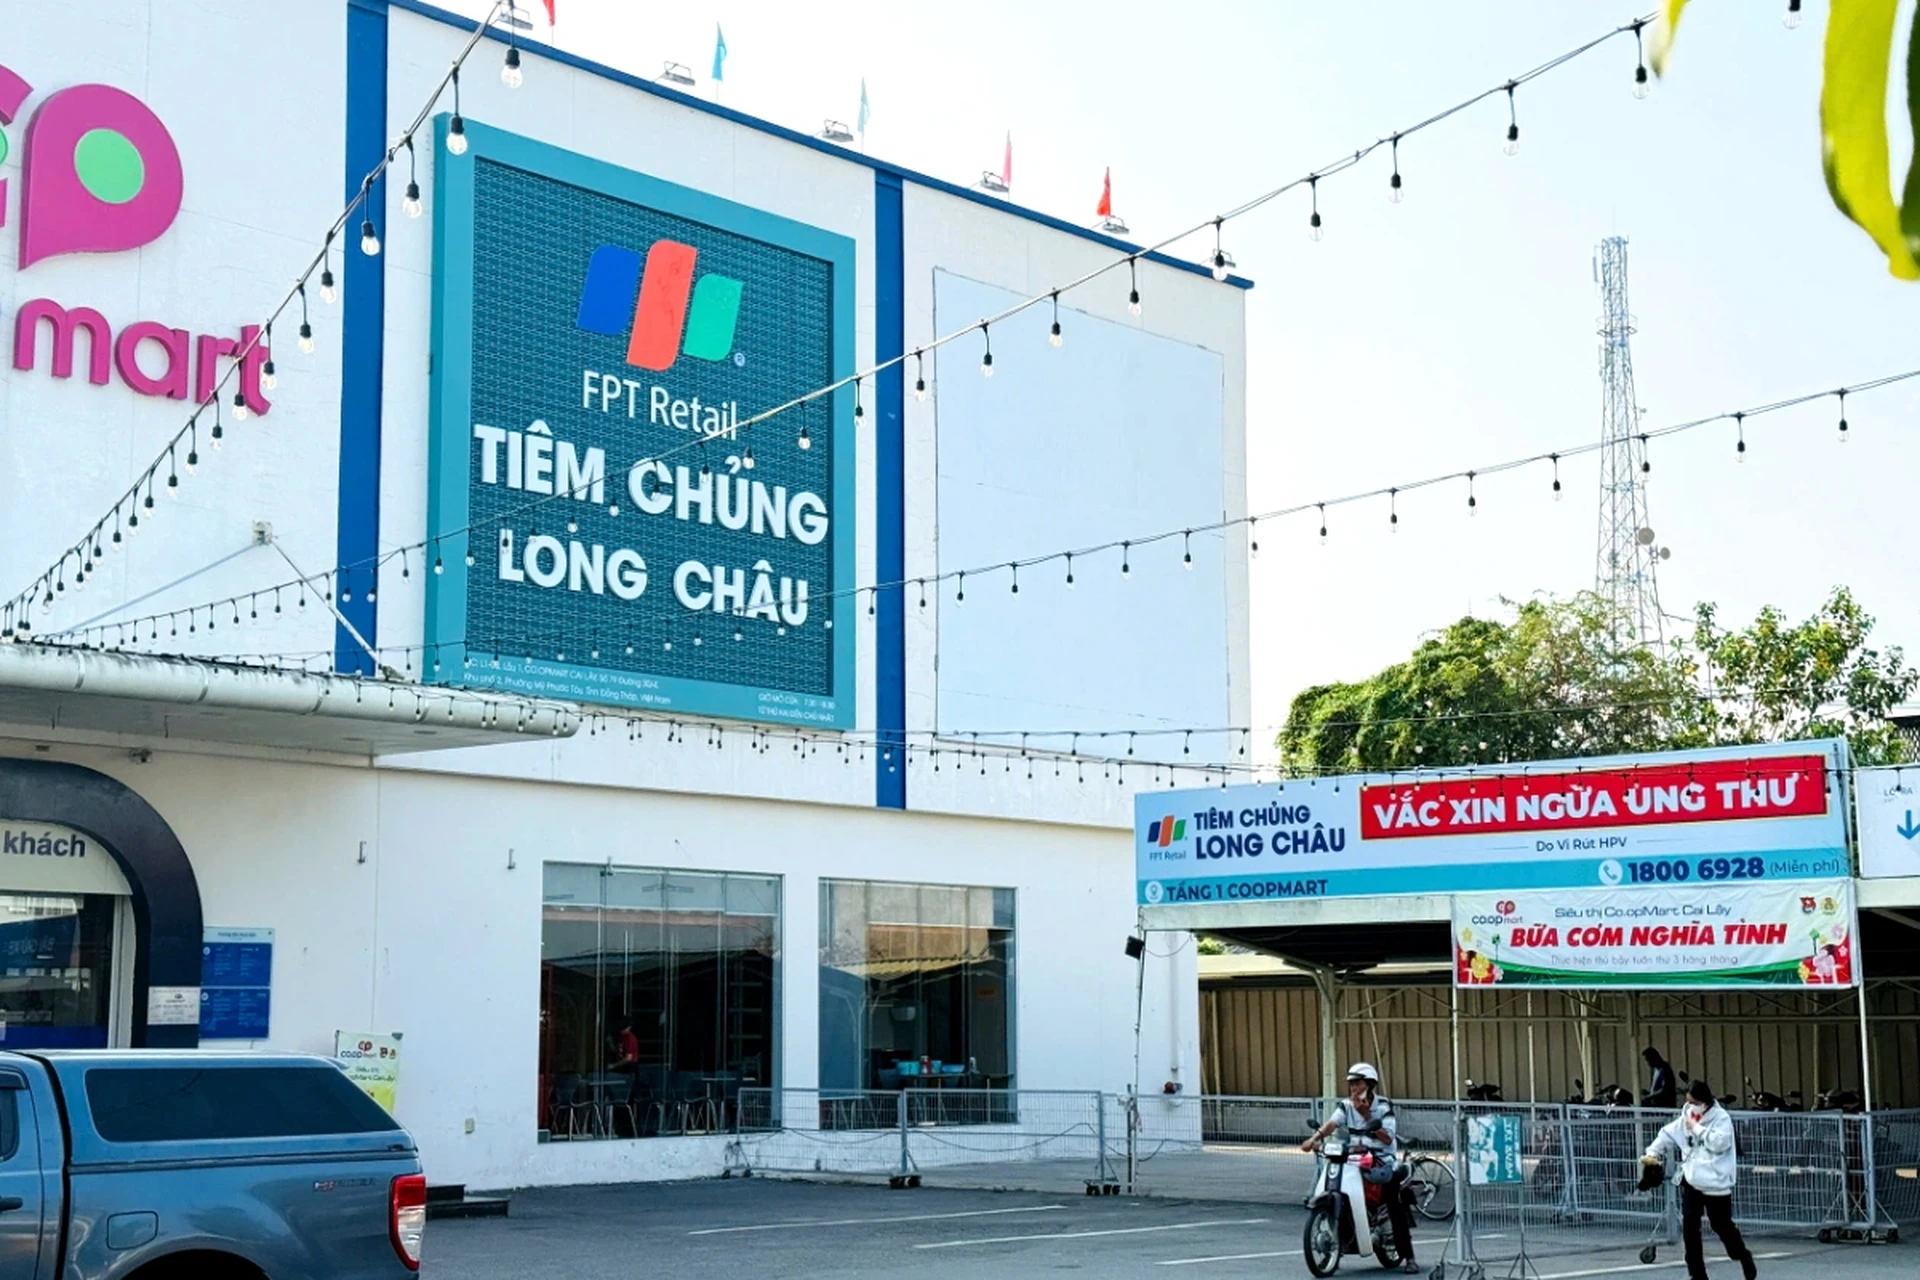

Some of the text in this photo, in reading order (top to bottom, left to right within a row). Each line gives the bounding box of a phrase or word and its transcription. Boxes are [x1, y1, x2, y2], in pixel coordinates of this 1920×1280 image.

[13, 297, 272, 416] mart
[583, 370, 737, 441] FPT Retail
[474, 419, 829, 545] TIÊM CHỦNG
[499, 528, 808, 626] LONG CHÂU
[1373, 772, 1800, 829] VẮC XIN NGỪA UNG THƯ
[1194, 801, 1311, 831] TIÊM CHỦNG
[3, 829, 86, 857] khách
[1196, 822, 1346, 859] LONG CHÂU
[1536, 841, 1554, 852] Do
[1572, 838, 1595, 850] Rút
[1600, 838, 1627, 849] HPV
[1150, 850, 1186, 861] FPT Retail
[1628, 857, 1840, 882] 1800 6928 (Miễn phí)
[1216, 884, 1223, 899] 1
[1228, 879, 1328, 899] COOPMART
[1555, 907, 1583, 918] Siêu
[1586, 907, 1602, 919] thị
[1604, 906, 1680, 919] Co.opMart
[1682, 905, 1703, 916] Cai
[1510, 918, 1788, 947] BỮA CƠM NGHĨA TÌNH
